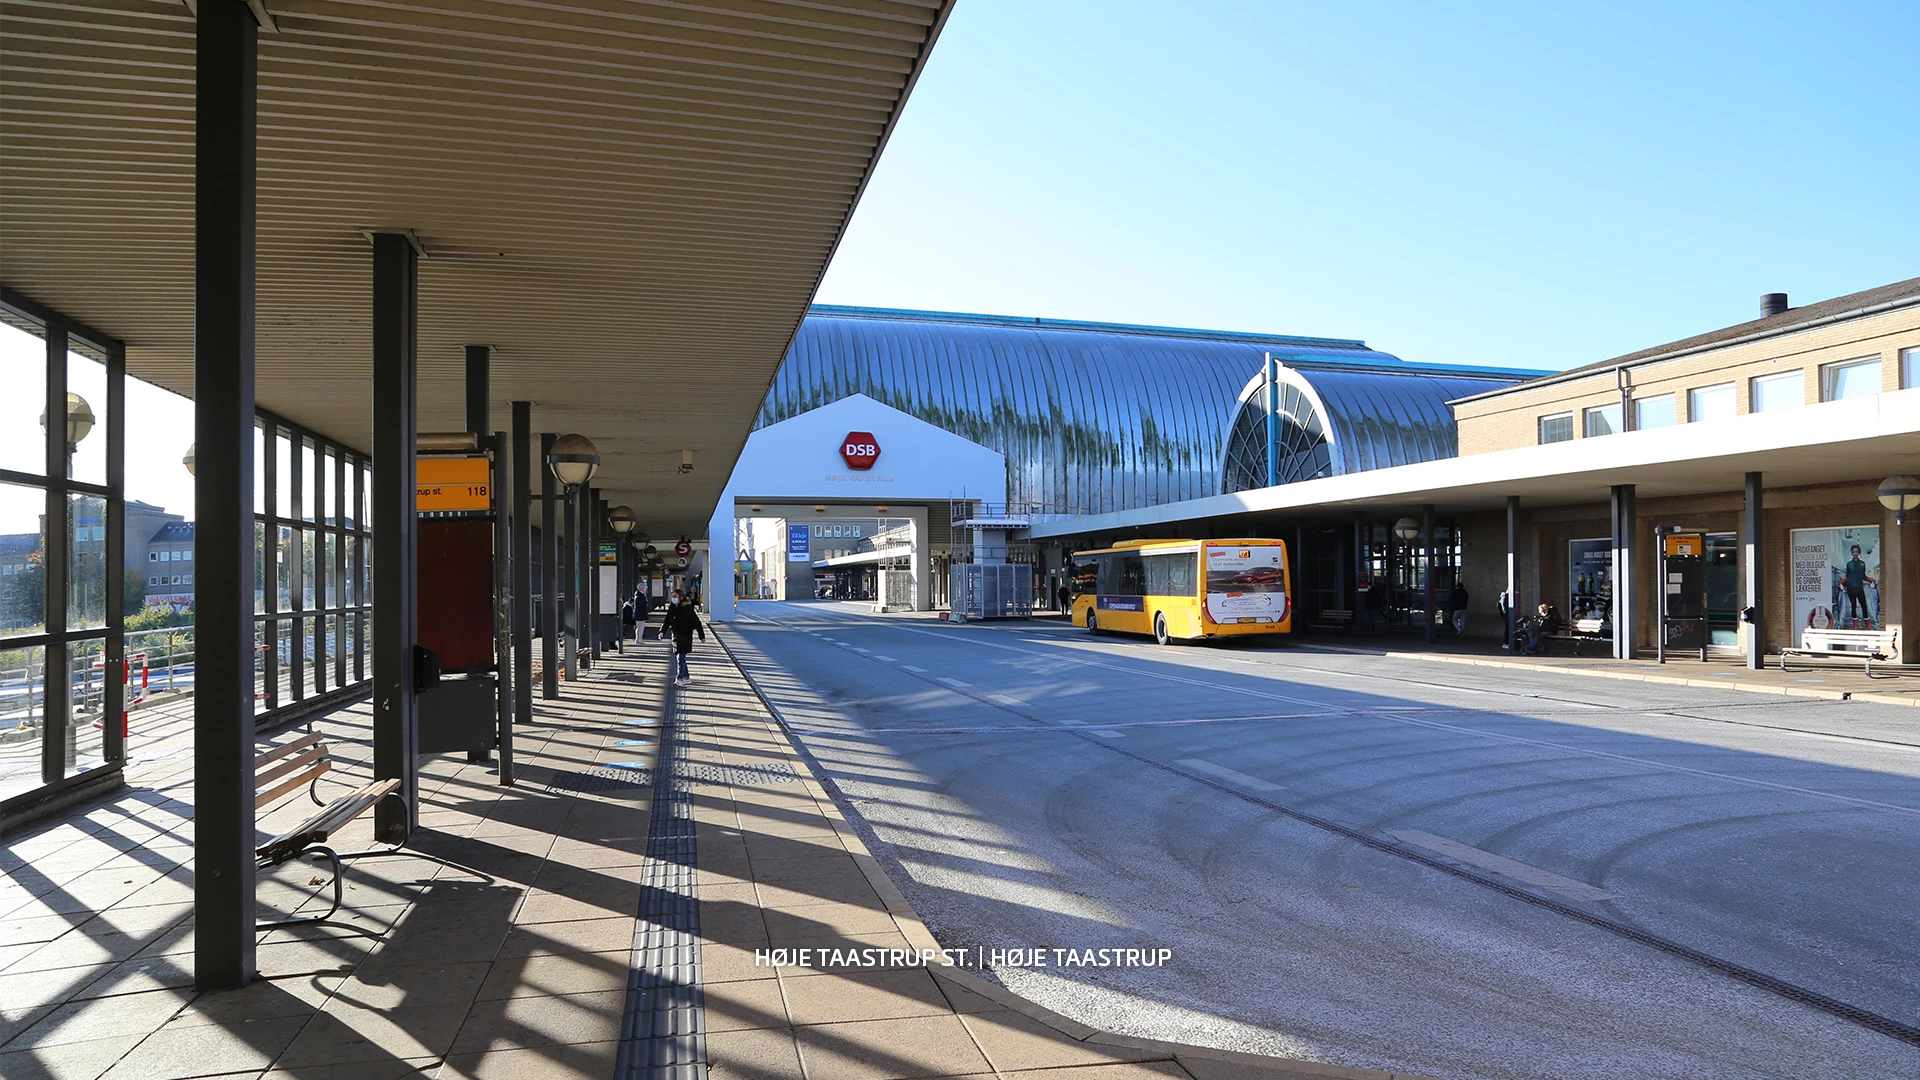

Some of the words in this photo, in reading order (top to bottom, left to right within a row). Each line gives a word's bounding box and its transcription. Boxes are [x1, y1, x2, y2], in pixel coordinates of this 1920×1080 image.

[846, 444, 876, 456] DSB
[468, 486, 487, 496] 118
[679, 543, 688, 554] S
[1795, 545, 1825, 553] FRISKFANGET
